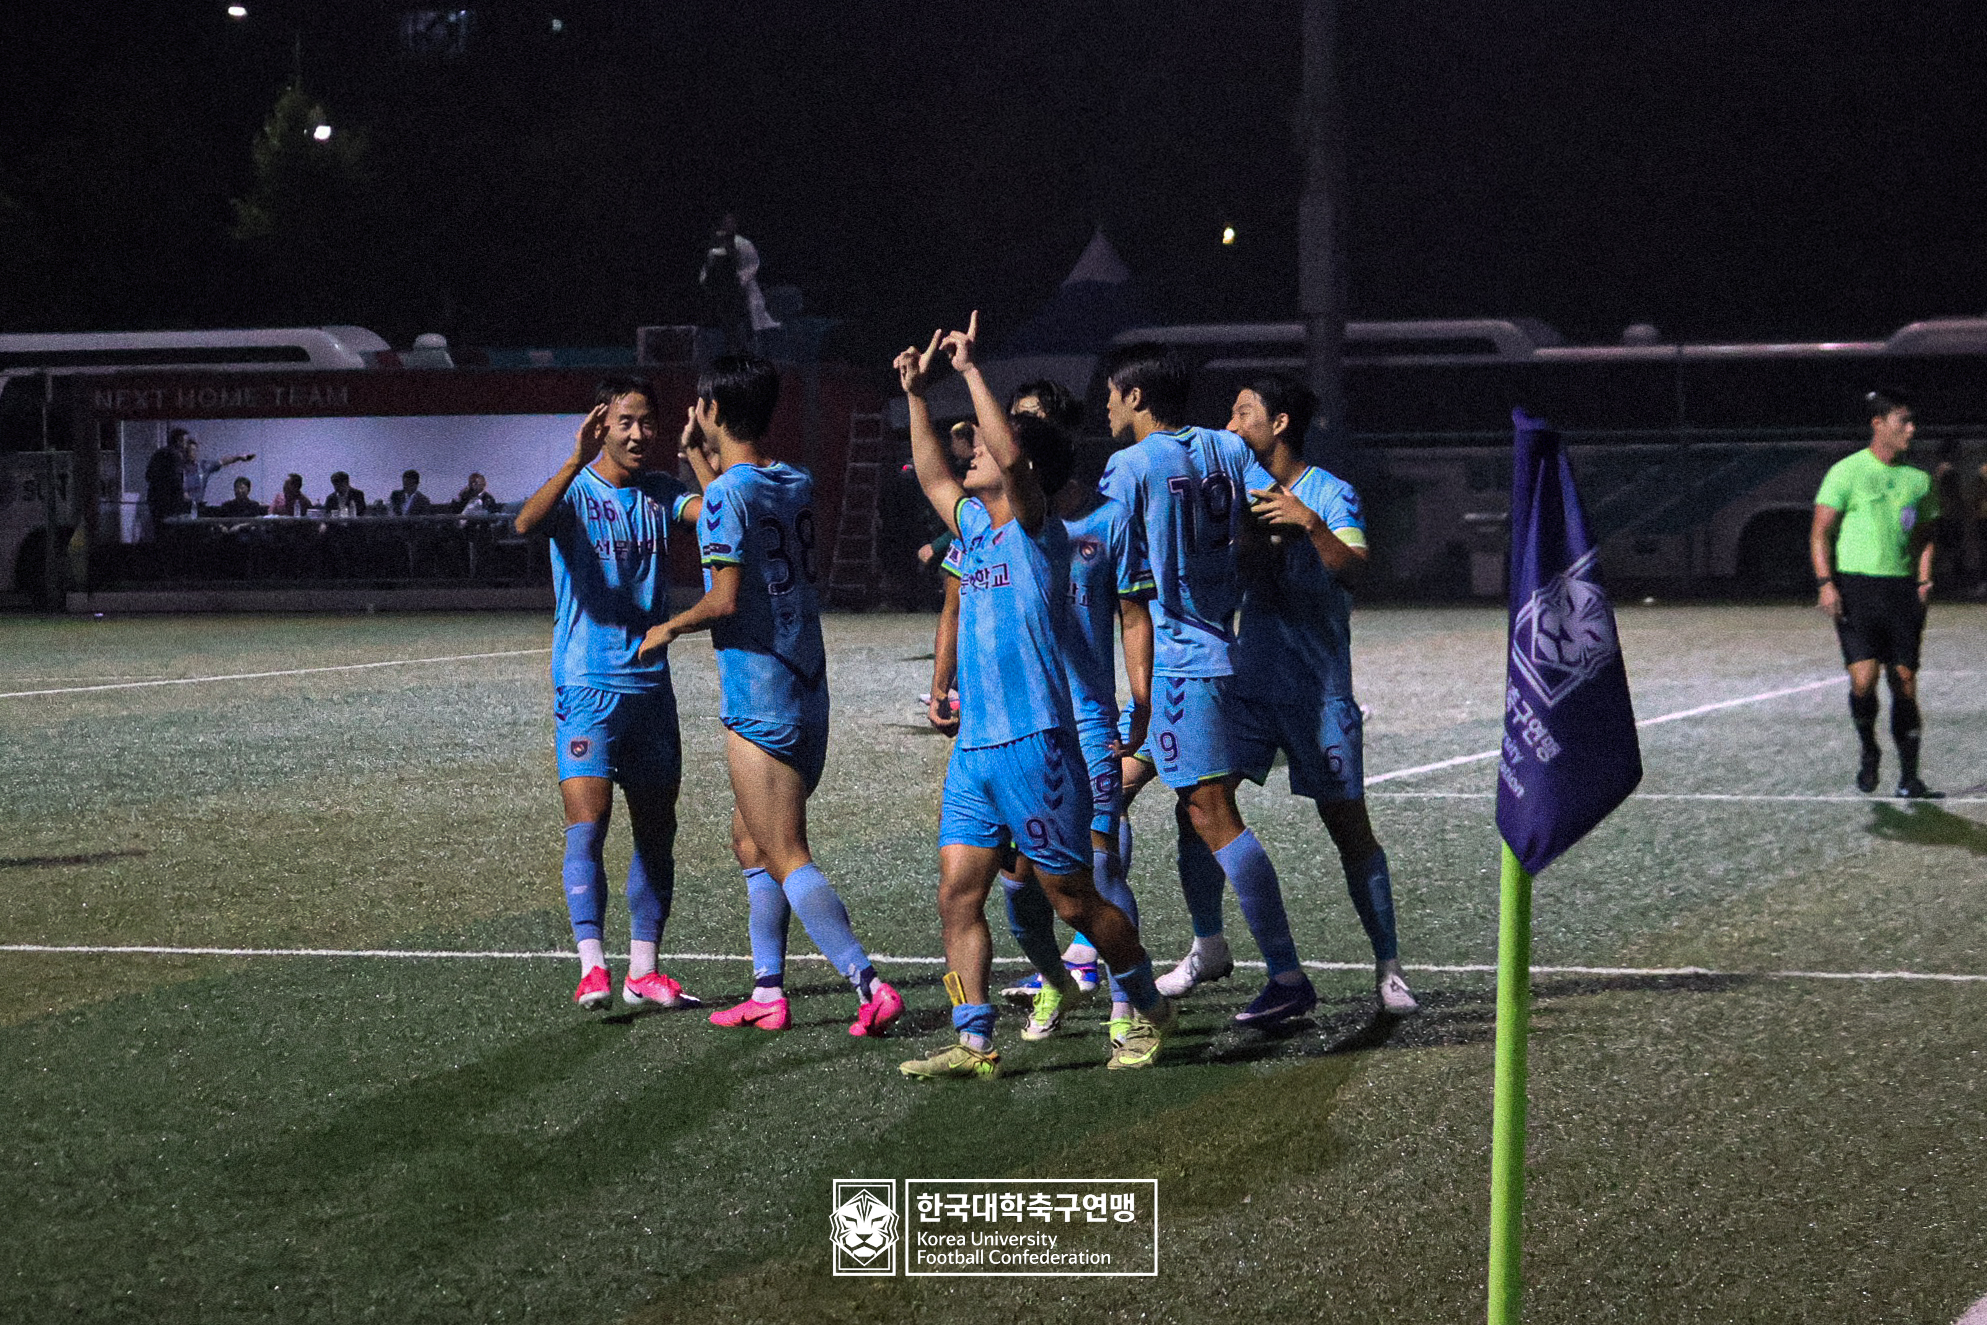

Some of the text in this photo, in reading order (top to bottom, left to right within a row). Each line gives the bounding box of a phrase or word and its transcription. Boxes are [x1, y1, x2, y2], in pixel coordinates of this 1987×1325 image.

[94, 385, 350, 409] NEXT HOME TEAM
